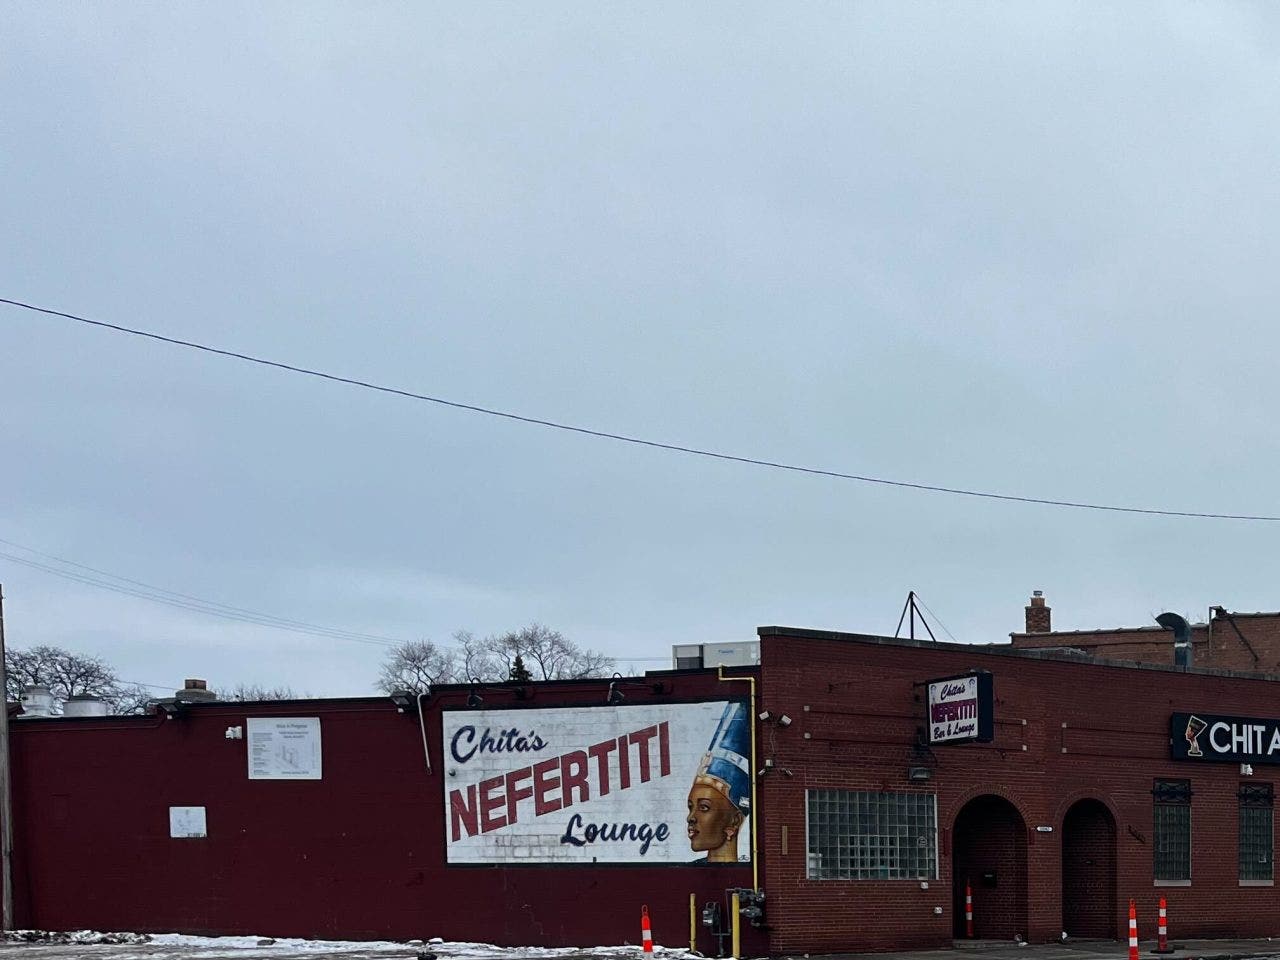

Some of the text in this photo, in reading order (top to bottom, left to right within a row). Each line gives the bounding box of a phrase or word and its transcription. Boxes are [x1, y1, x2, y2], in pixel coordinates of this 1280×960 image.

[940, 683, 966, 700] Chita's
[931, 698, 977, 724] NEFERTITI
[450, 725, 549, 763] Chita's
[933, 727, 945, 739] Bar
[953, 722, 975, 735] Lounge
[450, 721, 671, 842] NEFERTITI
[561, 813, 670, 855] Lounge
